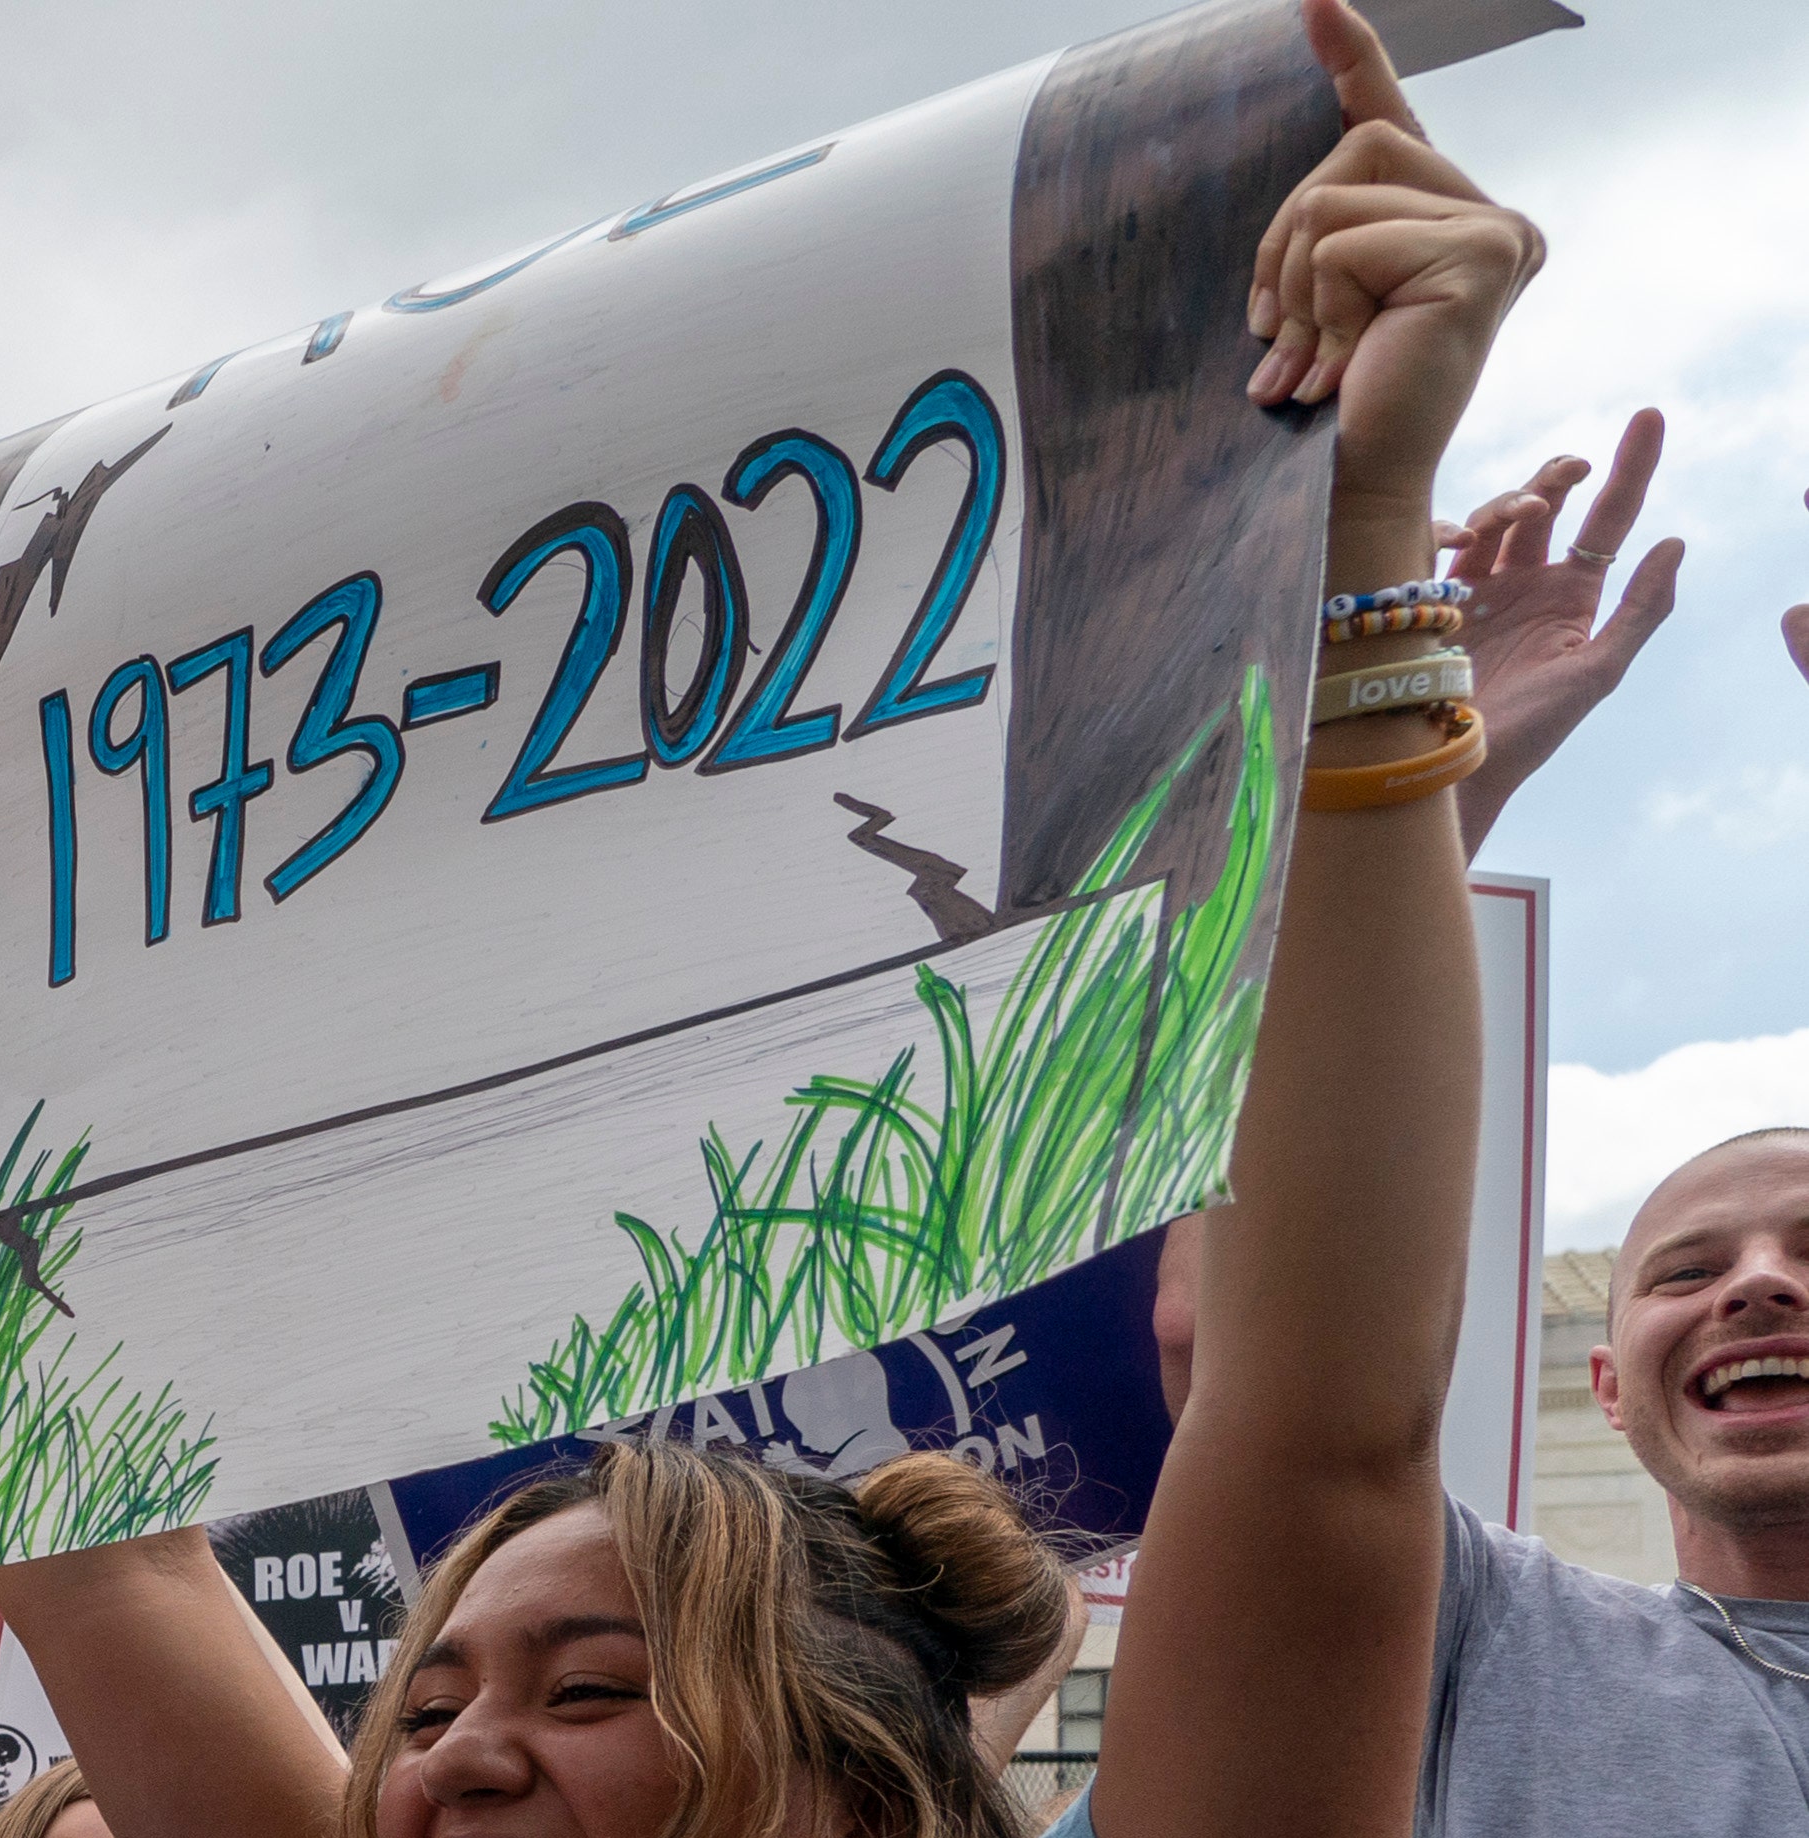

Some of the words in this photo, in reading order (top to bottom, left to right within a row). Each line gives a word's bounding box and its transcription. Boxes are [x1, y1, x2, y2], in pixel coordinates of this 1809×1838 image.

[39, 368, 1008, 990] 1973-2022
[252, 1551, 345, 1602] ROE
[338, 1599, 370, 1633] V.
